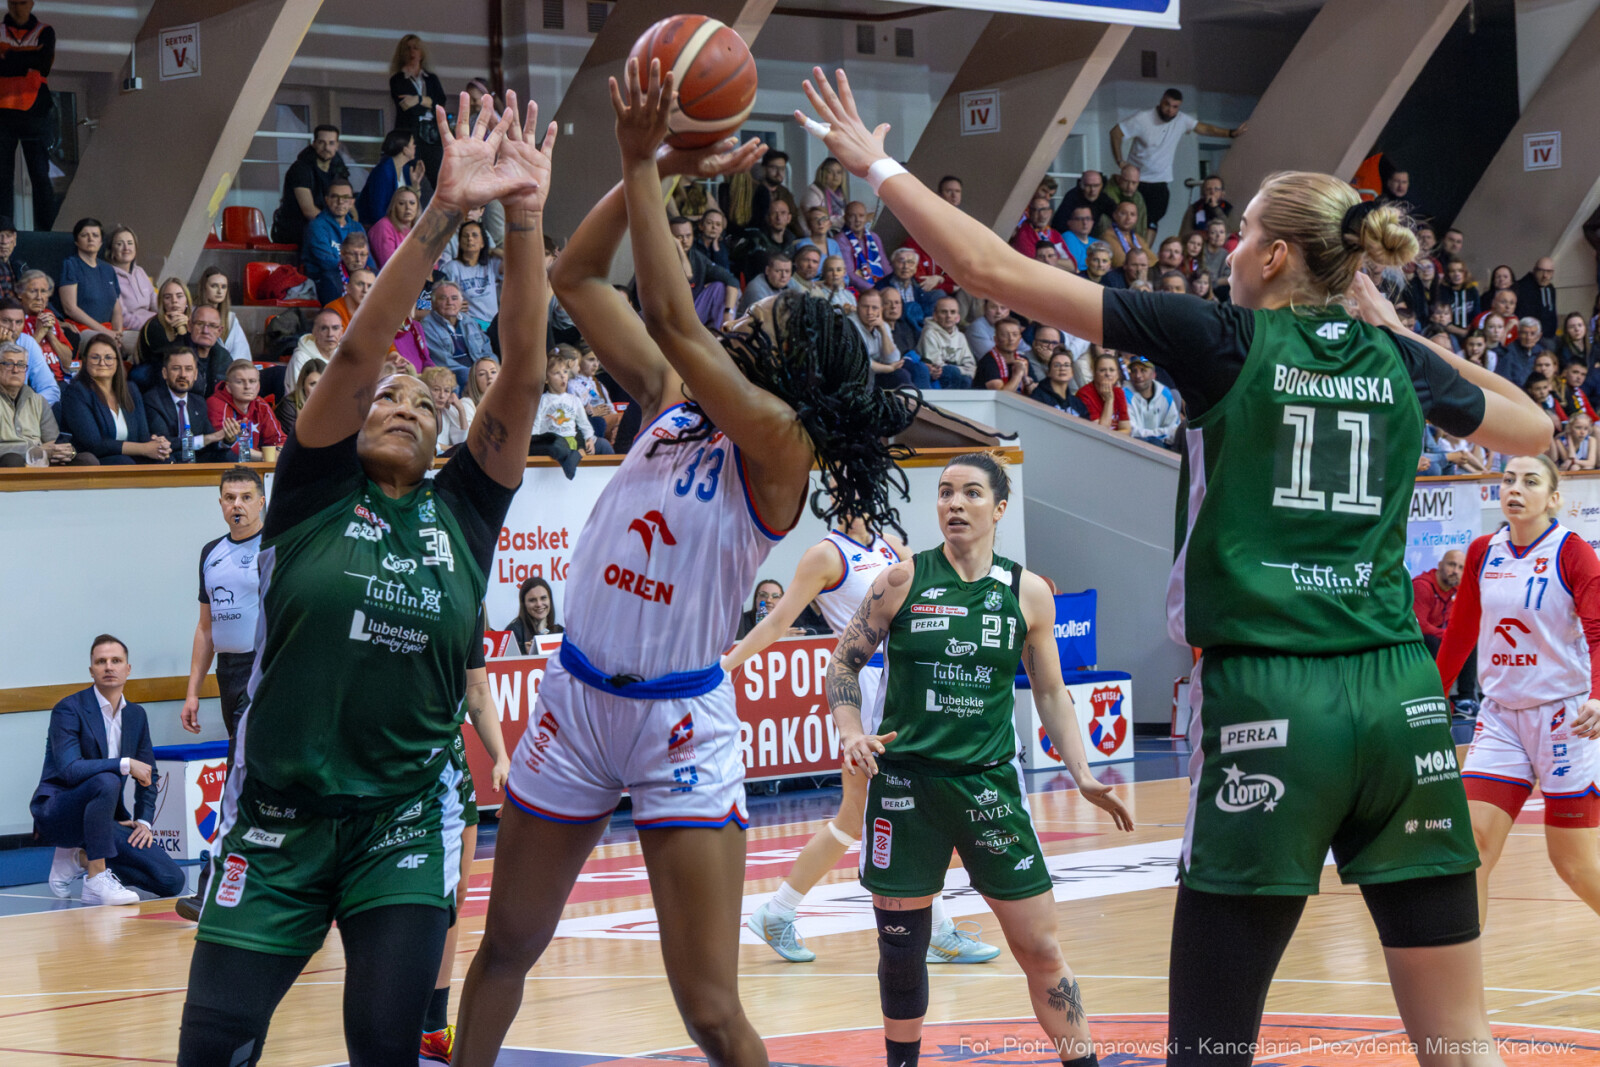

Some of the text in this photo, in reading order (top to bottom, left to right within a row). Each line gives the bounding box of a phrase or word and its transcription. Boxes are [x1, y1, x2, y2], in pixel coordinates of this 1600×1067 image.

[173, 47, 187, 68] V
[971, 107, 990, 125] IV
[1533, 147, 1552, 163] IV
[1315, 322, 1348, 340] 4F
[1273, 364, 1394, 404] BORKOWSKA
[1272, 405, 1382, 516] 11
[674, 446, 725, 503] 33
[1410, 491, 1453, 518] AMY!
[498, 526, 569, 551] Basket
[418, 527, 454, 572] 34
[604, 563, 675, 606] ORLEN
[920, 587, 948, 600] 4F
[1523, 576, 1549, 611] 17
[217, 612, 242, 621] Pekao
[914, 620, 945, 630] PERŁA
[981, 614, 1017, 650] 21
[1053, 620, 1092, 638] molten
[951, 643, 972, 655] LOTTO
[1491, 653, 1538, 667] ORLEN
[743, 648, 832, 702] SPOR
[1405, 702, 1437, 716] SEMPER
[740, 704, 841, 769] RAKÓW
[1228, 726, 1278, 745] PERŁA
[203, 772, 215, 785] TS
[1552, 766, 1572, 777] 4F
[1228, 782, 1270, 804] LOTTO
[884, 799, 911, 808] PERŁA
[965, 803, 1014, 822] TAVEX
[1425, 818, 1452, 830] UMCS
[397, 853, 429, 869] 4F
[1014, 854, 1035, 871] 4F
